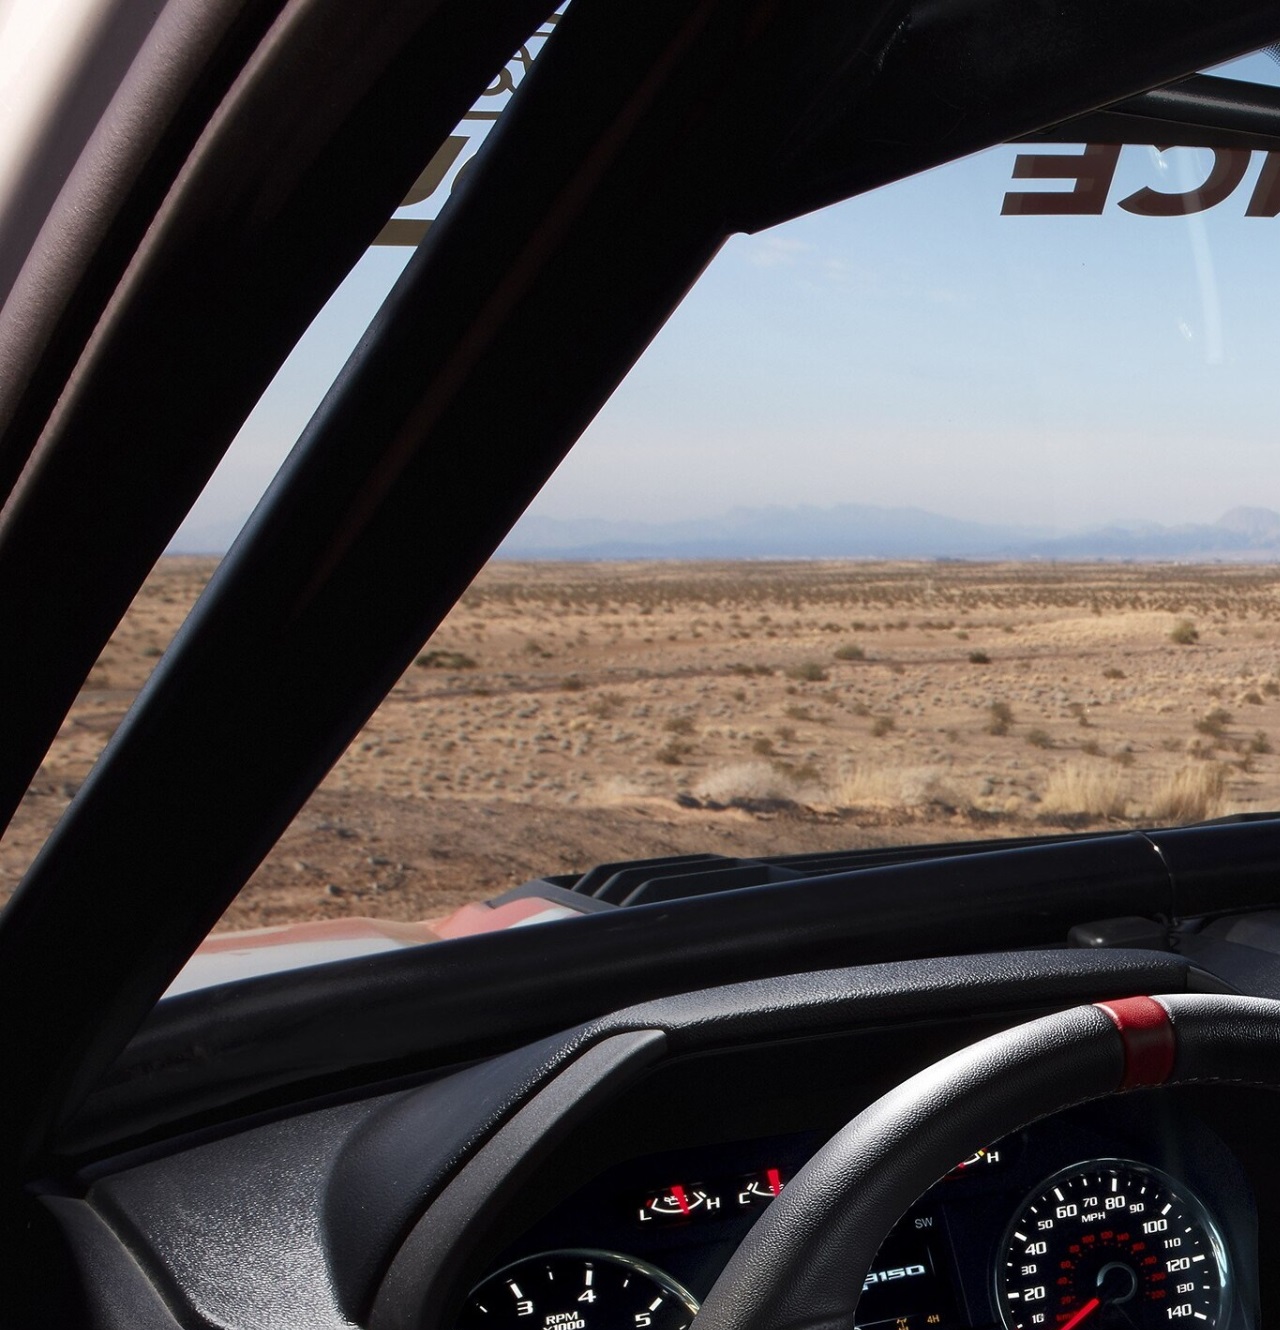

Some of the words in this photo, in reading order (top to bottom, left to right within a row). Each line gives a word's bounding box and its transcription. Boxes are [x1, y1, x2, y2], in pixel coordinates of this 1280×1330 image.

[986, 1151, 1000, 1164] H
[706, 1197, 721, 1210] H
[1083, 1196, 1098, 1208] 70
[1105, 1195, 1126, 1210] 80
[1129, 1203, 1145, 1213] 90
[639, 1209, 652, 1221] L
[1056, 1204, 1078, 1219] 60
[1081, 1212, 1106, 1223] MPH
[914, 1217, 933, 1229] SW
[1037, 1219, 1054, 1231] 50
[1143, 1219, 1168, 1234] 100
[1025, 1241, 1047, 1256] 40
[1164, 1237, 1181, 1249] 110
[1021, 1264, 1037, 1276] 30
[1166, 1257, 1190, 1272] 120
[1024, 1286, 1046, 1301] 20
[1176, 1282, 1195, 1294] 130
[577, 1289, 597, 1303] 4
[517, 1300, 534, 1316] 3
[1167, 1303, 1192, 1319] 140
[545, 1311, 579, 1326] RPM
[635, 1312, 652, 1328] 5
[927, 1314, 940, 1325] 4H
